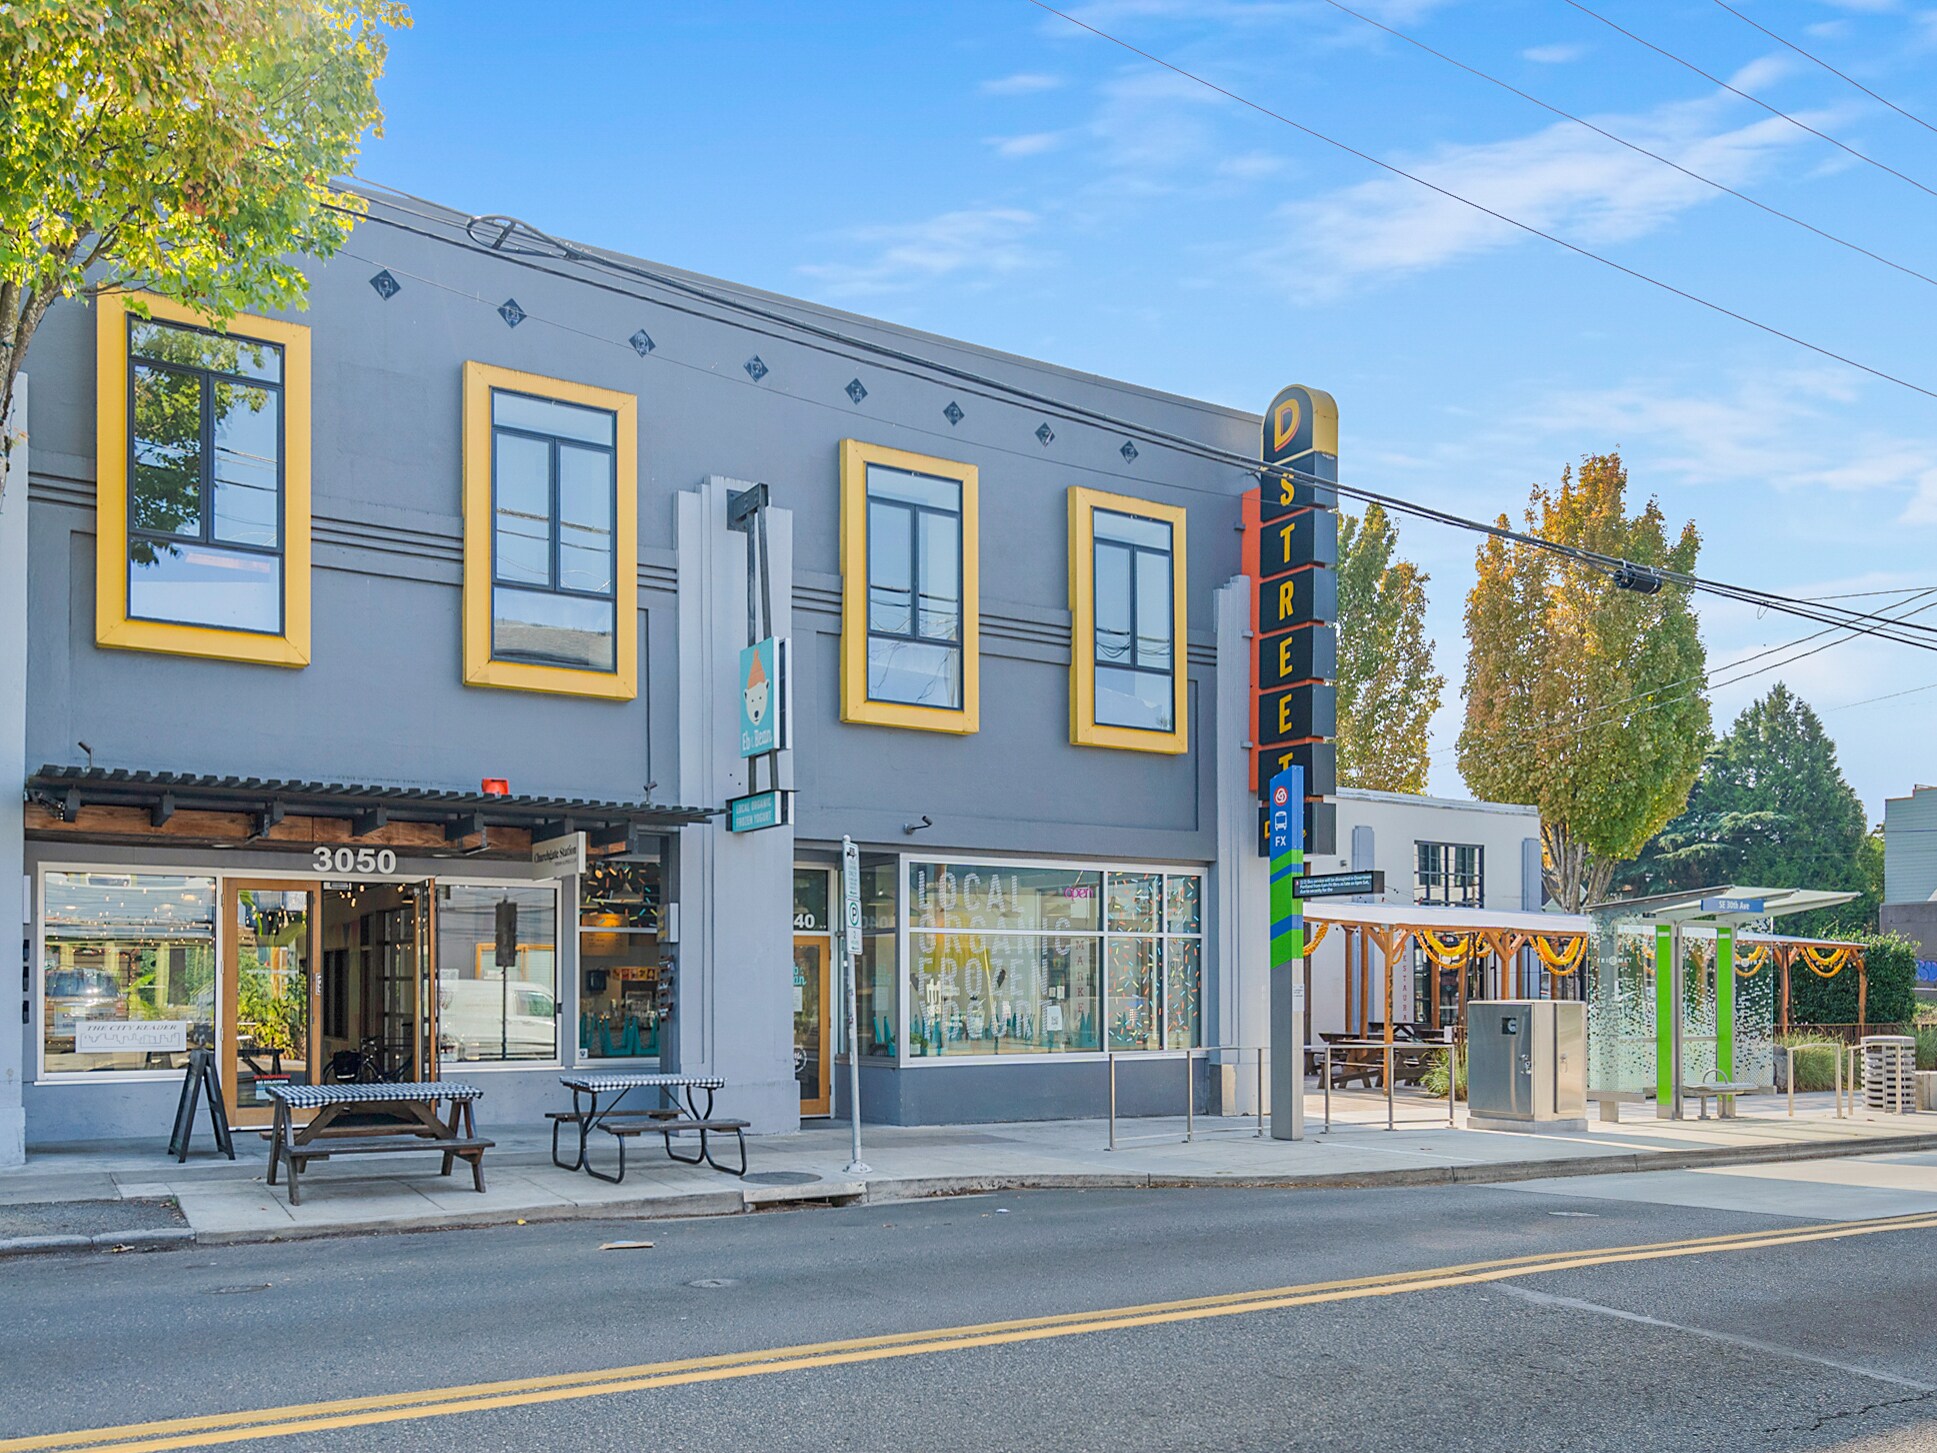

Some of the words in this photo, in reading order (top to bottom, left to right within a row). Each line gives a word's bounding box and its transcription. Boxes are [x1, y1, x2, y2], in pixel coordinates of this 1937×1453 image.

[1274, 398, 1301, 453] D
[736, 802, 750, 814] LOCAL
[751, 796, 772, 811] ORGANIC
[736, 814, 753, 828] FROZEN
[754, 810, 771, 824] YOGURT
[559, 844, 577, 858] Station
[1275, 836, 1287, 847] FX
[312, 846, 397, 874] 3050
[918, 870, 1025, 913] LOCAL
[1719, 901, 1726, 909] SE
[1727, 901, 1739, 909] 30th
[1739, 902, 1751, 910] Ave
[918, 914, 1071, 956] ORGANIC
[918, 957, 1049, 997] FROZEN
[919, 1000, 1053, 1040] YOGURT
